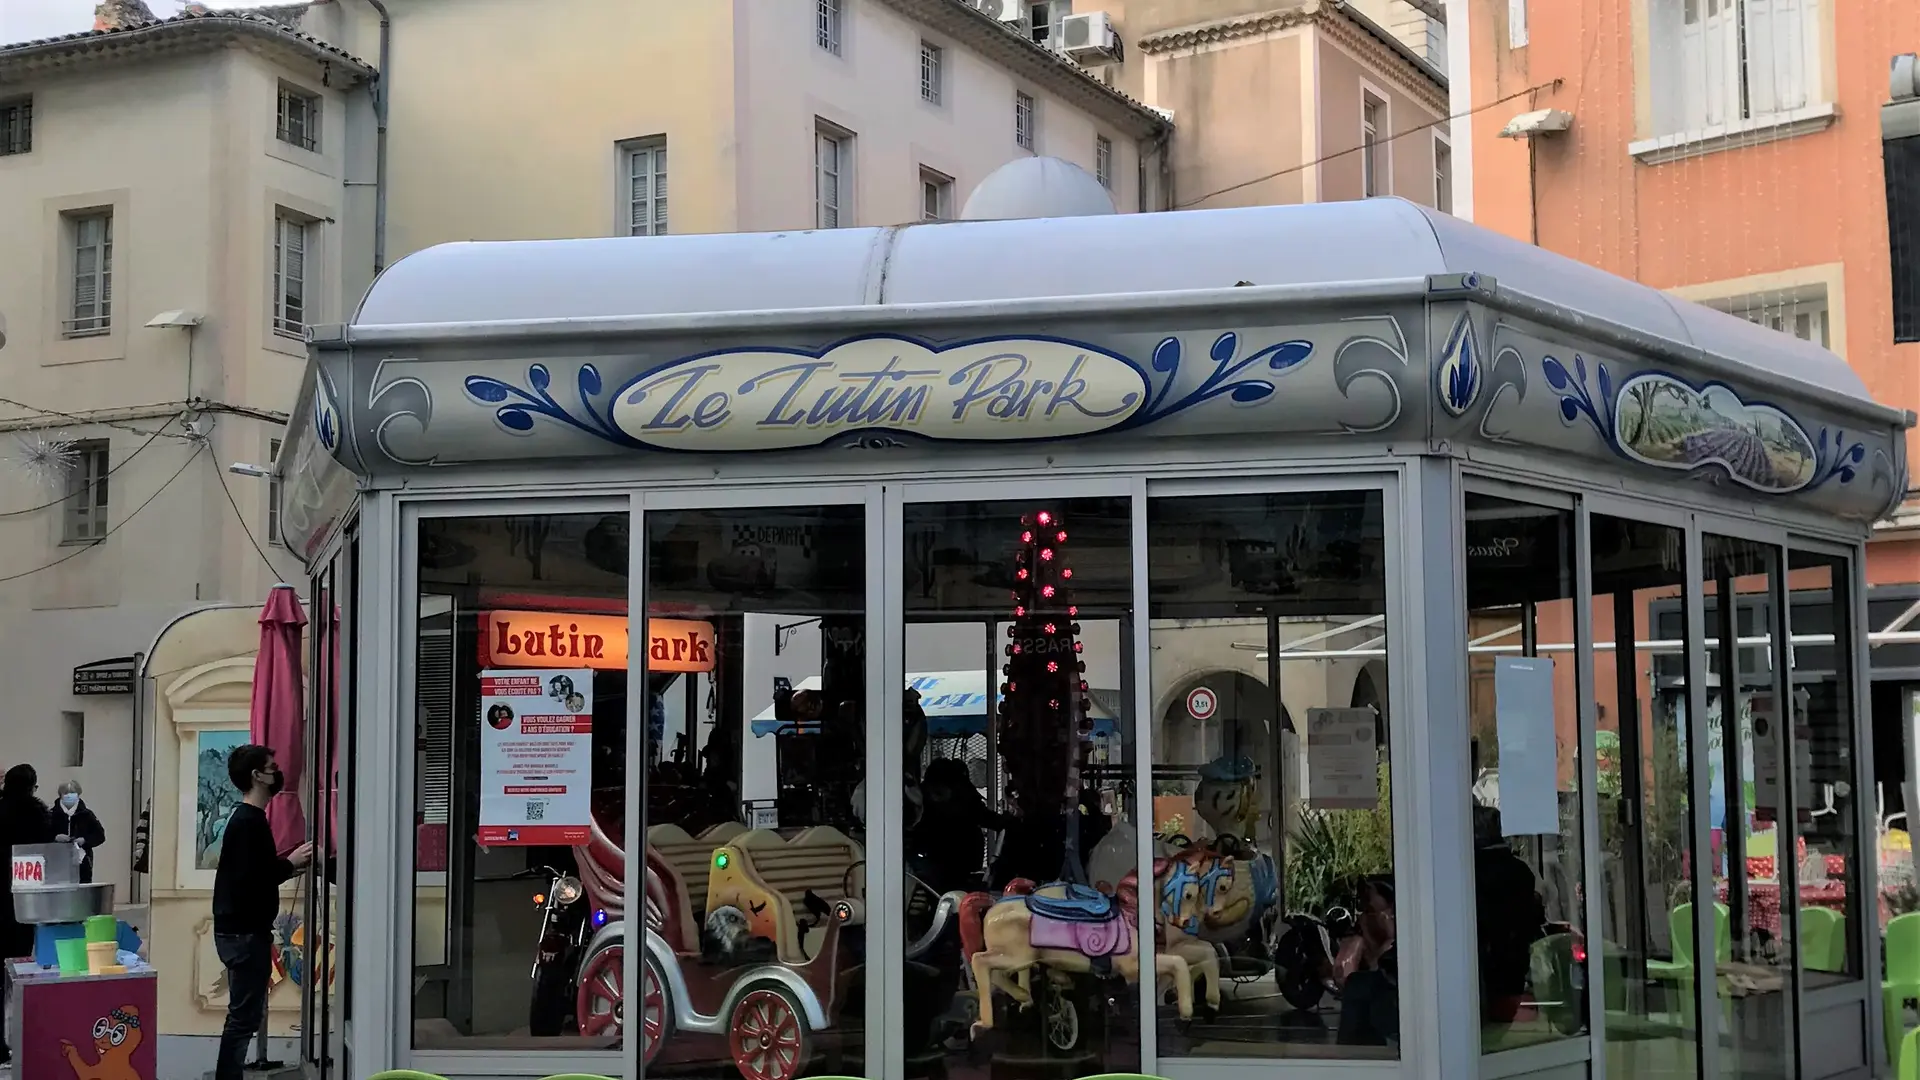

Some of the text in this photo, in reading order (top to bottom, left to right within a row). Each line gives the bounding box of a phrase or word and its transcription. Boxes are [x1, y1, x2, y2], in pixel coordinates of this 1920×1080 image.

[627, 354, 1141, 432] Le Lutin Park
[496, 621, 709, 663] Lutin ark
